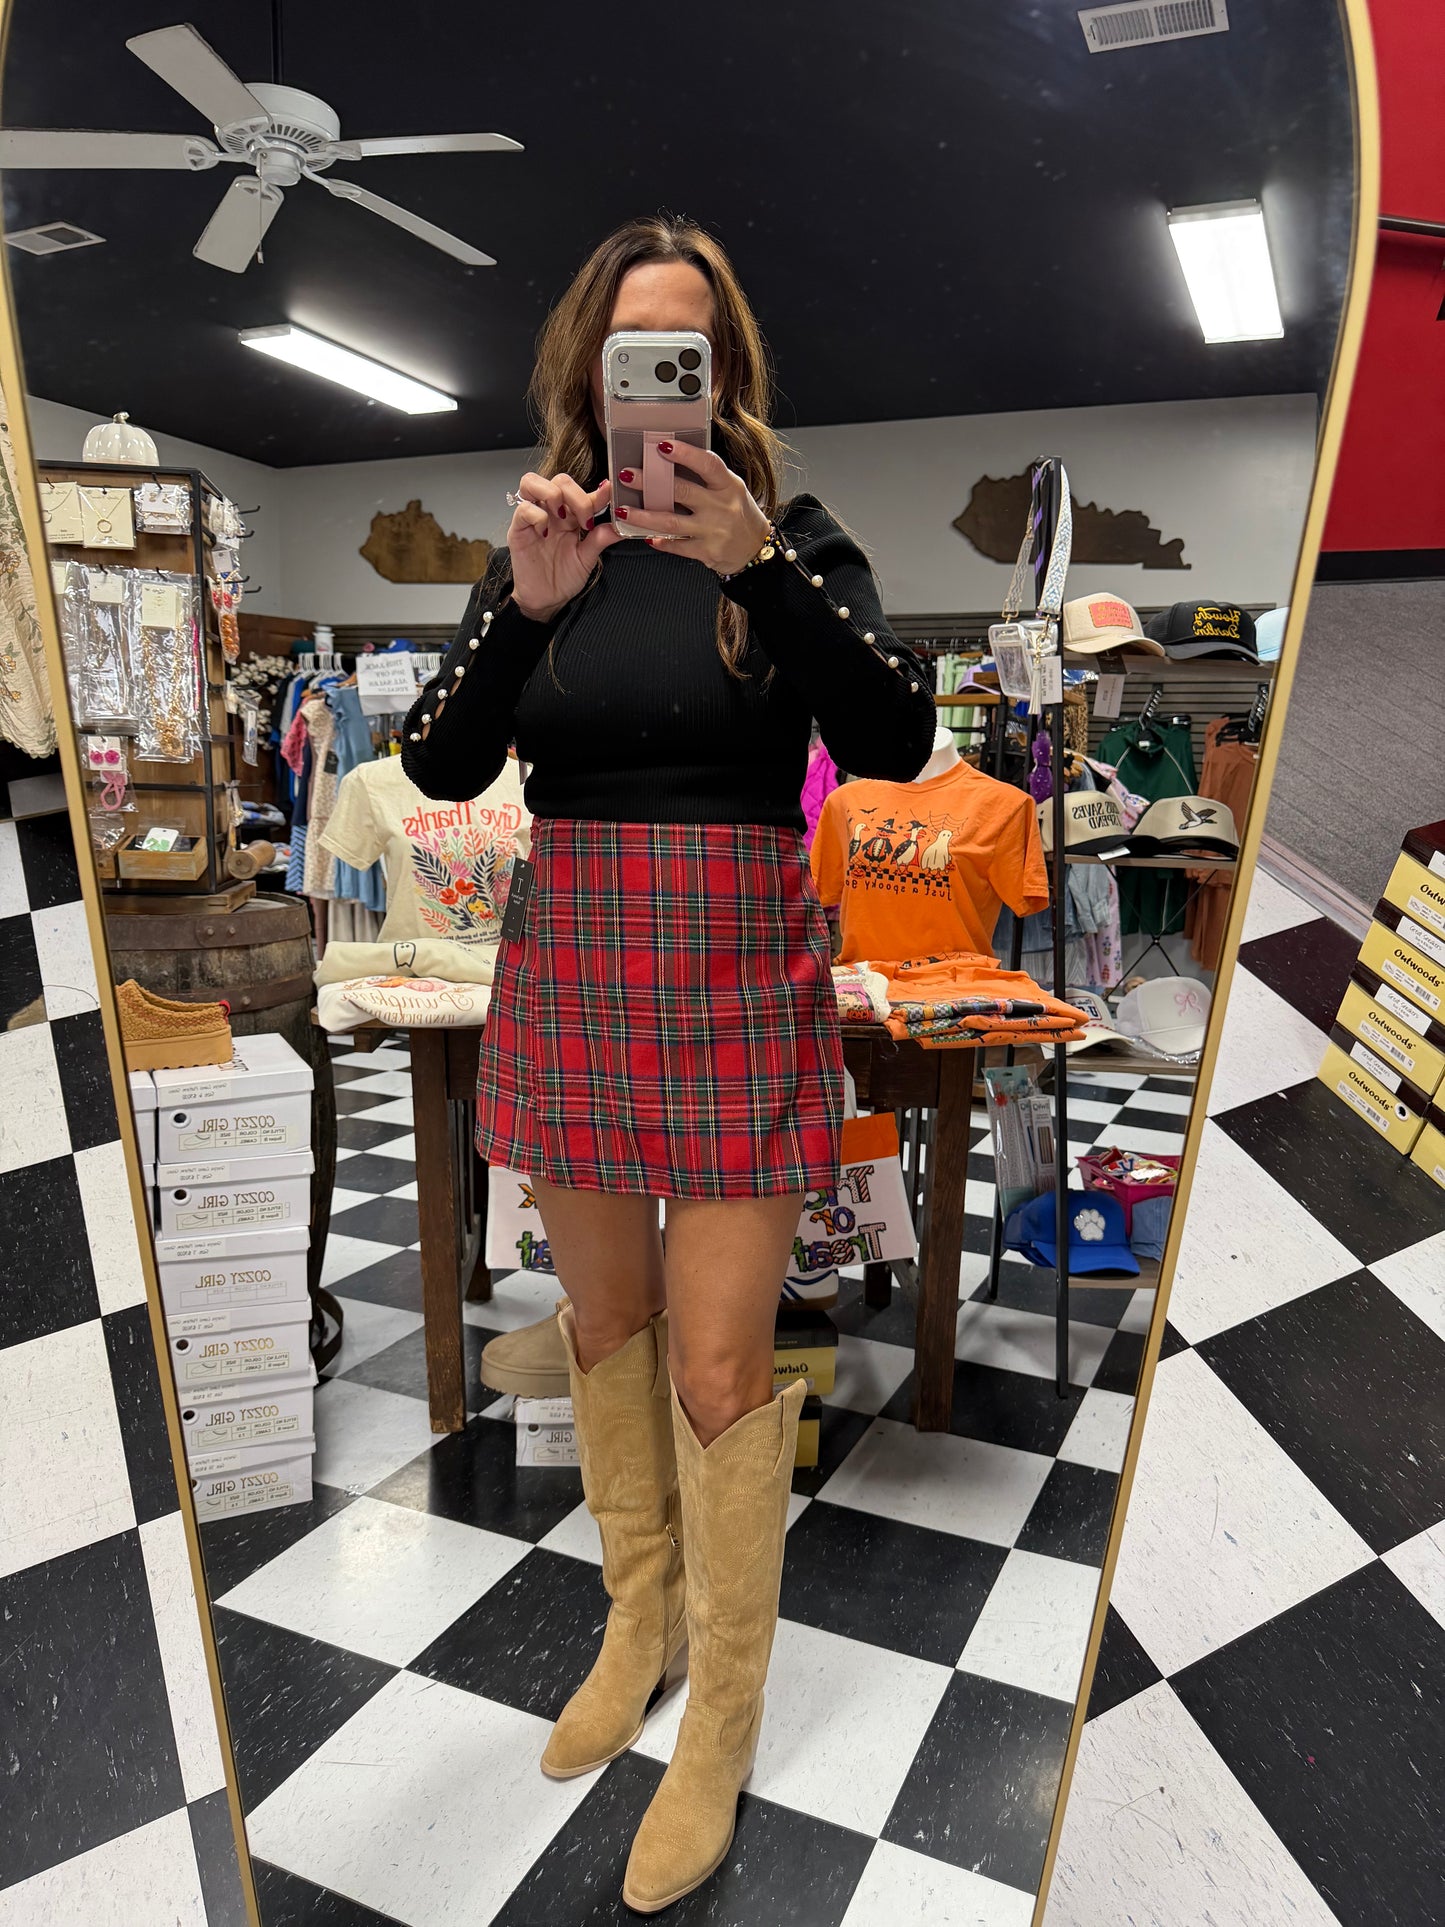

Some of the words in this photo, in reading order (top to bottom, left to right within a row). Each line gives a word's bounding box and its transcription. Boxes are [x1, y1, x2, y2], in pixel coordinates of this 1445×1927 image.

[1420, 884, 1445, 906] Outw
[1394, 949, 1440, 988] Outwoods
[1368, 1011, 1414, 1049] Outwoods
[1348, 1071, 1390, 1110] Outwoods
